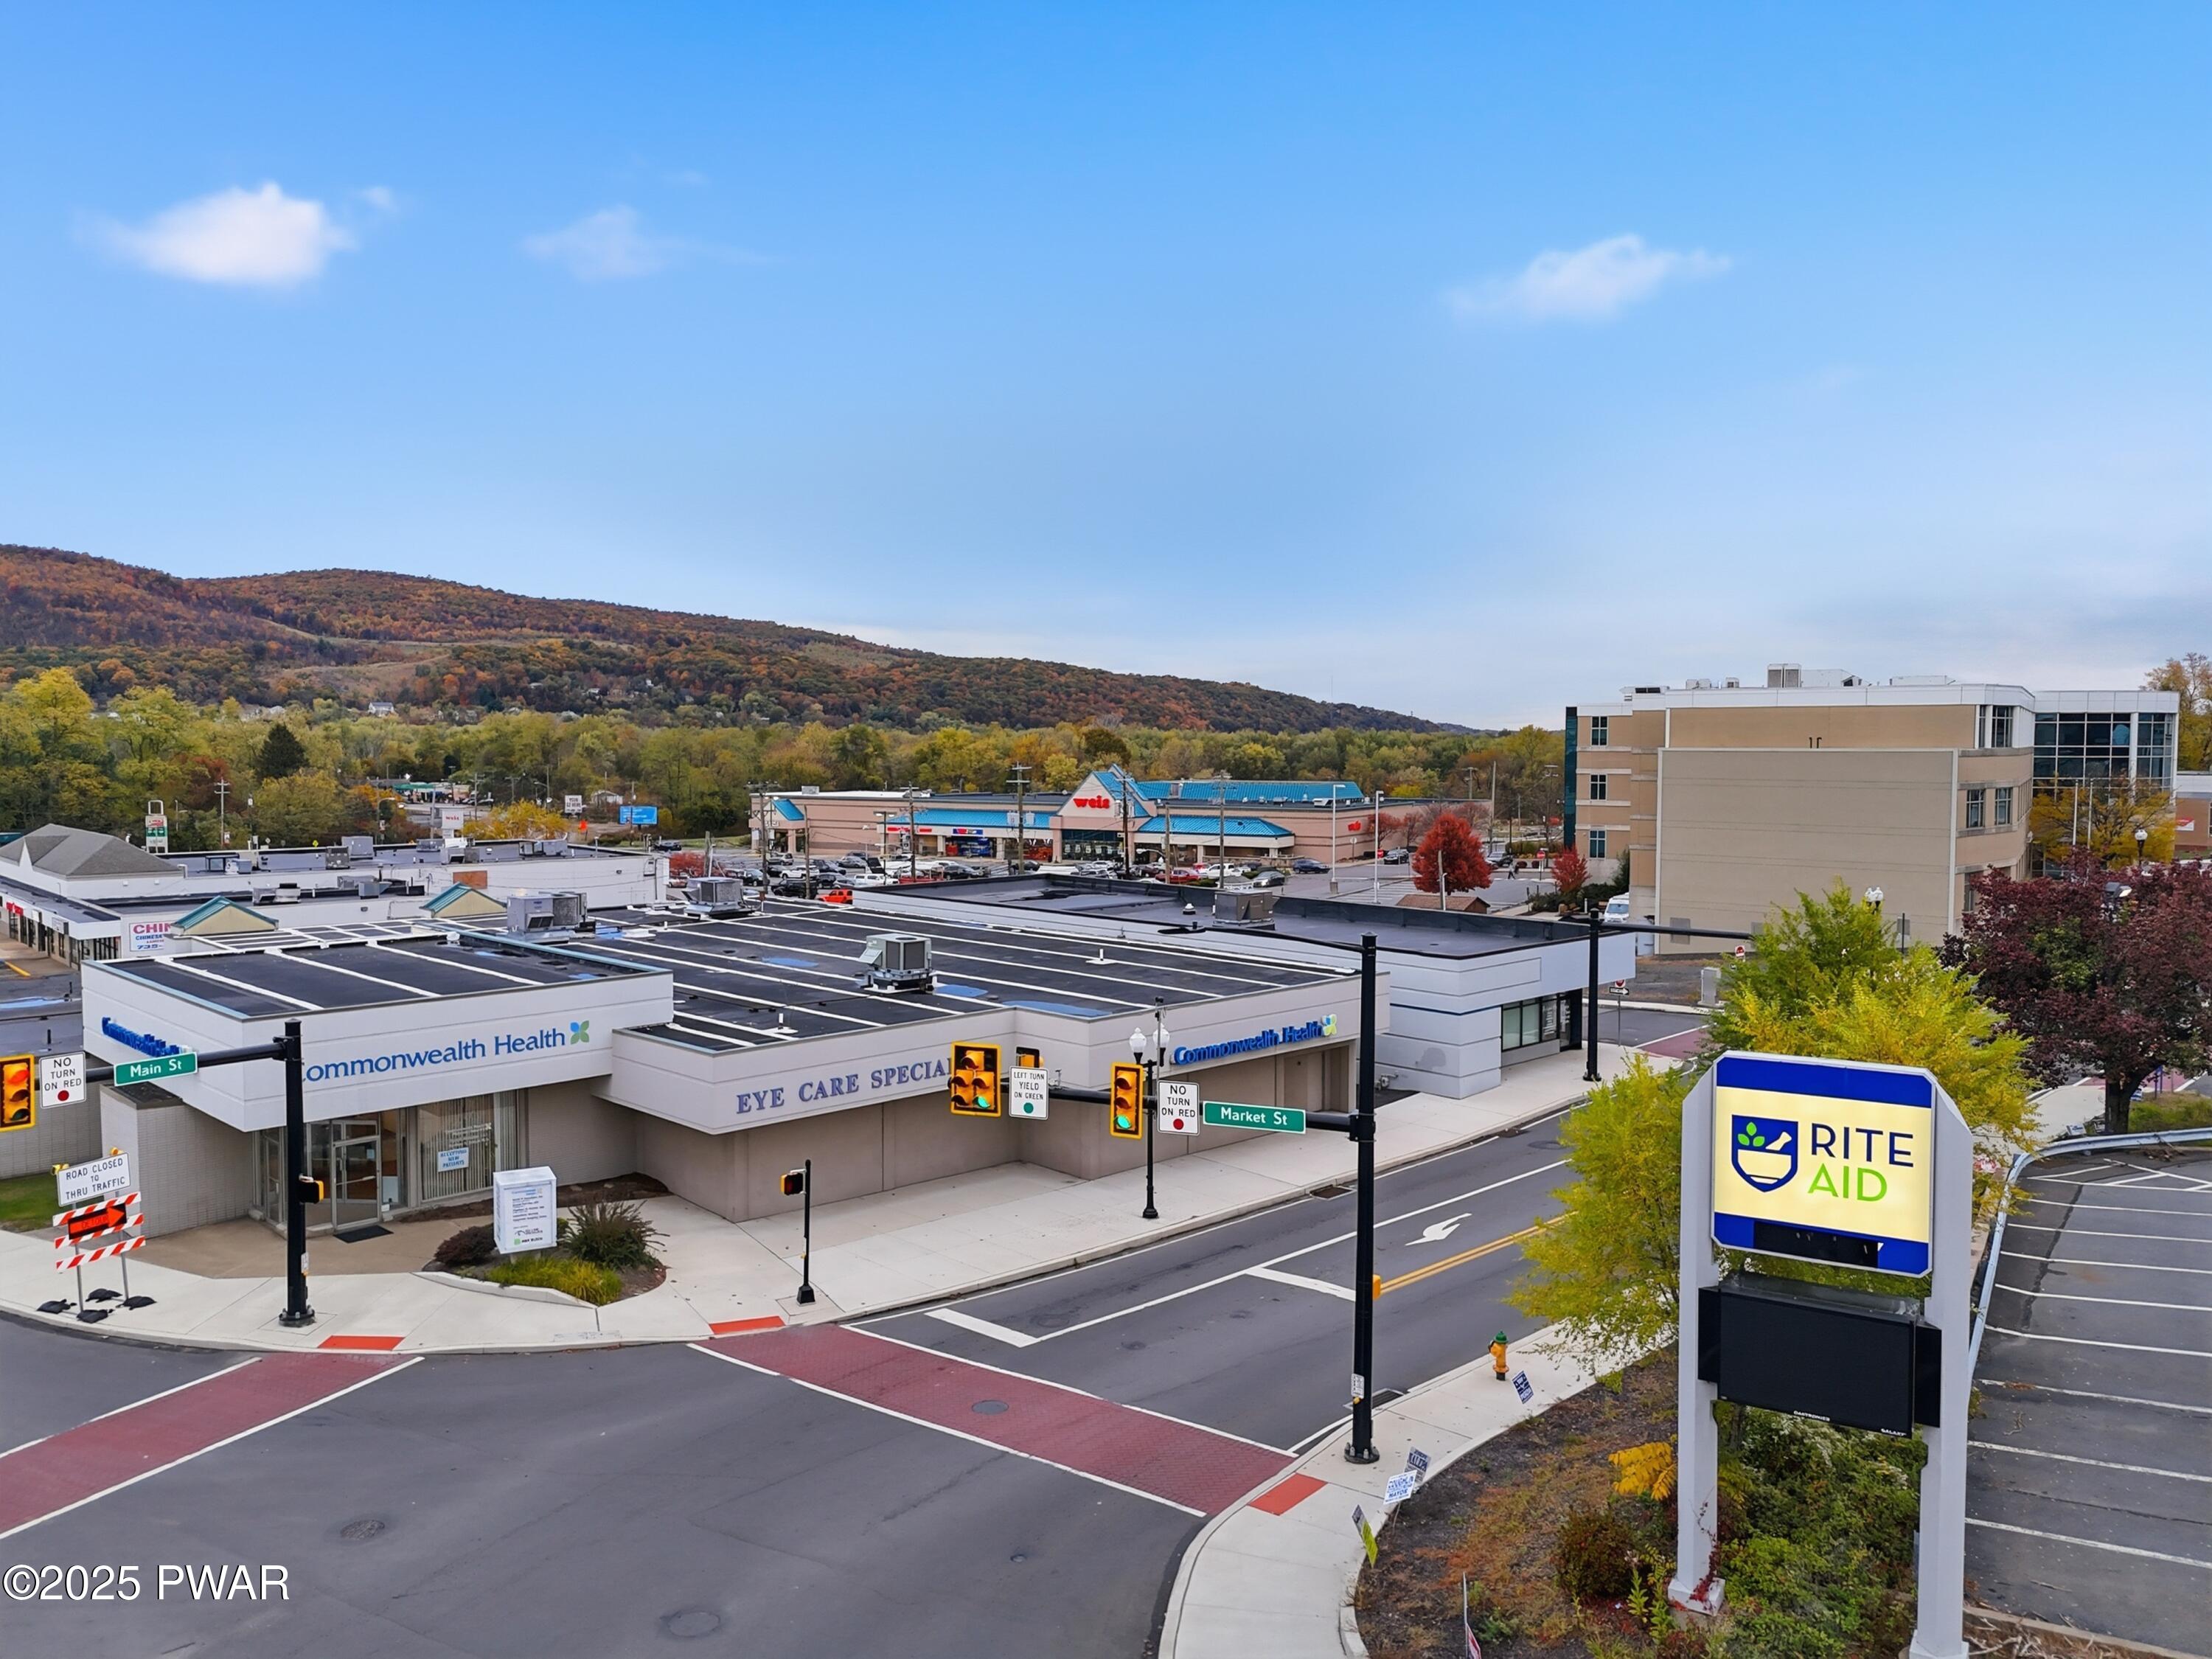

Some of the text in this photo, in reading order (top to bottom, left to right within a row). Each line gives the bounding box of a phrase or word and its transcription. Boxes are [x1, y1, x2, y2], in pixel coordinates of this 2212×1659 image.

[1073, 795, 1110, 810] weis
[1174, 1021, 1324, 1065] Commonwealth Health
[54, 1057, 72, 1068] NO
[303, 1028, 566, 1082] ommonwealth Health
[50, 1068, 76, 1079] TURN
[130, 1058, 182, 1078] Main St
[44, 1079, 82, 1091] ON RED
[737, 1057, 951, 1114] EYE CARE SPECIA
[1019, 1082, 1039, 1091] YIELD
[1169, 1085, 1186, 1095] NO
[1167, 1096, 1190, 1106] TURN
[1161, 1107, 1196, 1118] ON RED
[1220, 1107, 1287, 1125] Market St
[1811, 1122, 1914, 1168] RITE
[66, 1158, 123, 1180] ROAD CLOSED
[91, 1175, 100, 1183] TO
[1807, 1162, 1888, 1202] AID
[66, 1177, 125, 1200] THRU TRAFFIC
